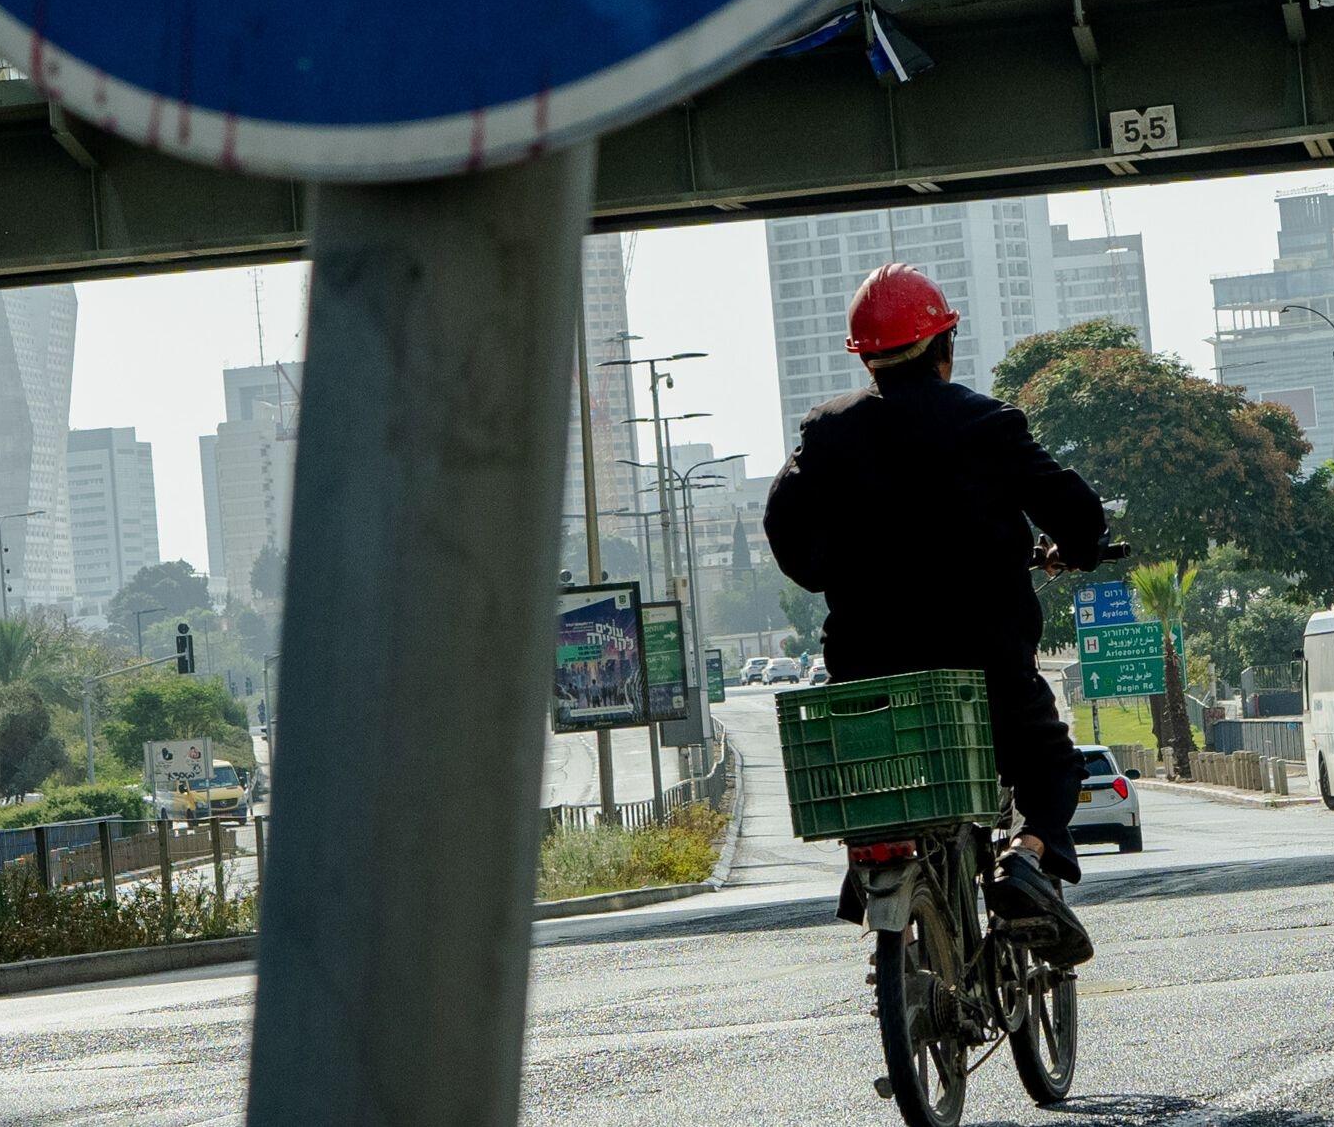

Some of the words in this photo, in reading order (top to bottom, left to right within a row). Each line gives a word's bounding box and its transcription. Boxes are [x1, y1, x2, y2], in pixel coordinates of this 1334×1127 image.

[1123, 116, 1166, 143] 5.5
[1102, 610, 1129, 618] Ayalon
[1101, 627, 1141, 637] ארלוזורוב
[1106, 649, 1145, 657] Arlozorov
[1116, 685, 1139, 693] Begin
